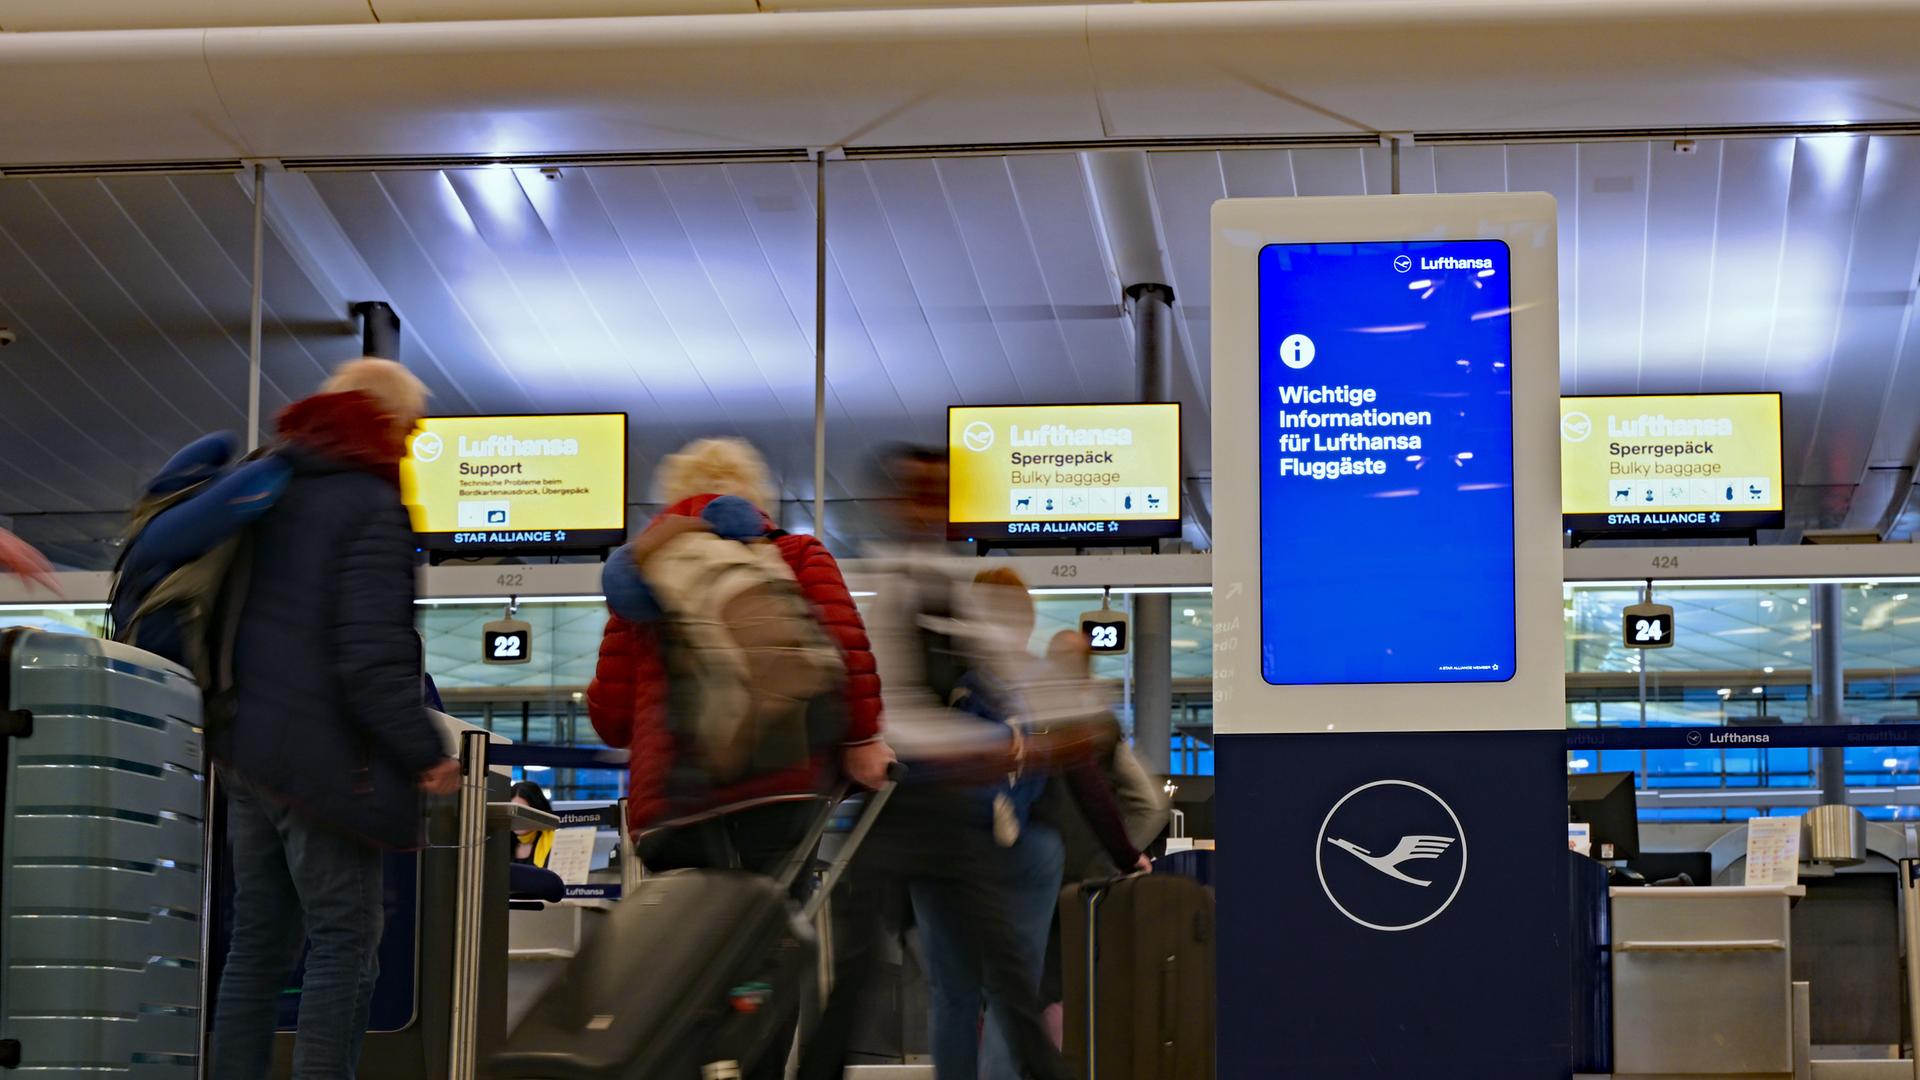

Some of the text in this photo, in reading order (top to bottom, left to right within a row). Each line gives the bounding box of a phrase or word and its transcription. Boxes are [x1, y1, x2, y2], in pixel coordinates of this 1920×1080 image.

[1420, 256, 1493, 271] Lufthansa
[1278, 385, 1377, 407] Wichtige
[1279, 408, 1432, 428] Informationen
[1608, 414, 1732, 437] Lufthansa
[1010, 424, 1131, 447] Lufthansa
[1279, 432, 1422, 452] für Lufthansa
[459, 435, 578, 457] Lufthansa
[1610, 441, 1714, 457] Sperrgepäck
[1011, 451, 1113, 467] Sperrgepäck
[459, 462, 523, 477] Support
[1280, 456, 1387, 480] Fluggäste
[1610, 461, 1721, 477] Bulky baggage
[460, 479, 502, 487] Technische
[504, 478, 541, 486] Probleme
[1011, 470, 1120, 486] Bulky baggage
[542, 486, 589, 496] Übergepäck
[1608, 513, 1706, 524] STAR ALLIANCE
[1008, 522, 1105, 533] STAR ALLIANCE
[454, 531, 552, 543] STAR ALLIANCE
[1651, 556, 1679, 569] 424
[1051, 565, 1078, 577] 423
[497, 575, 523, 587] 422
[1091, 626, 1118, 648] 23
[1635, 619, 1662, 641] 24
[494, 635, 520, 657] 22
[1709, 732, 1770, 744] Lufthansa
[558, 814, 600, 824] ufthansa
[566, 888, 604, 896] Lufthansa
